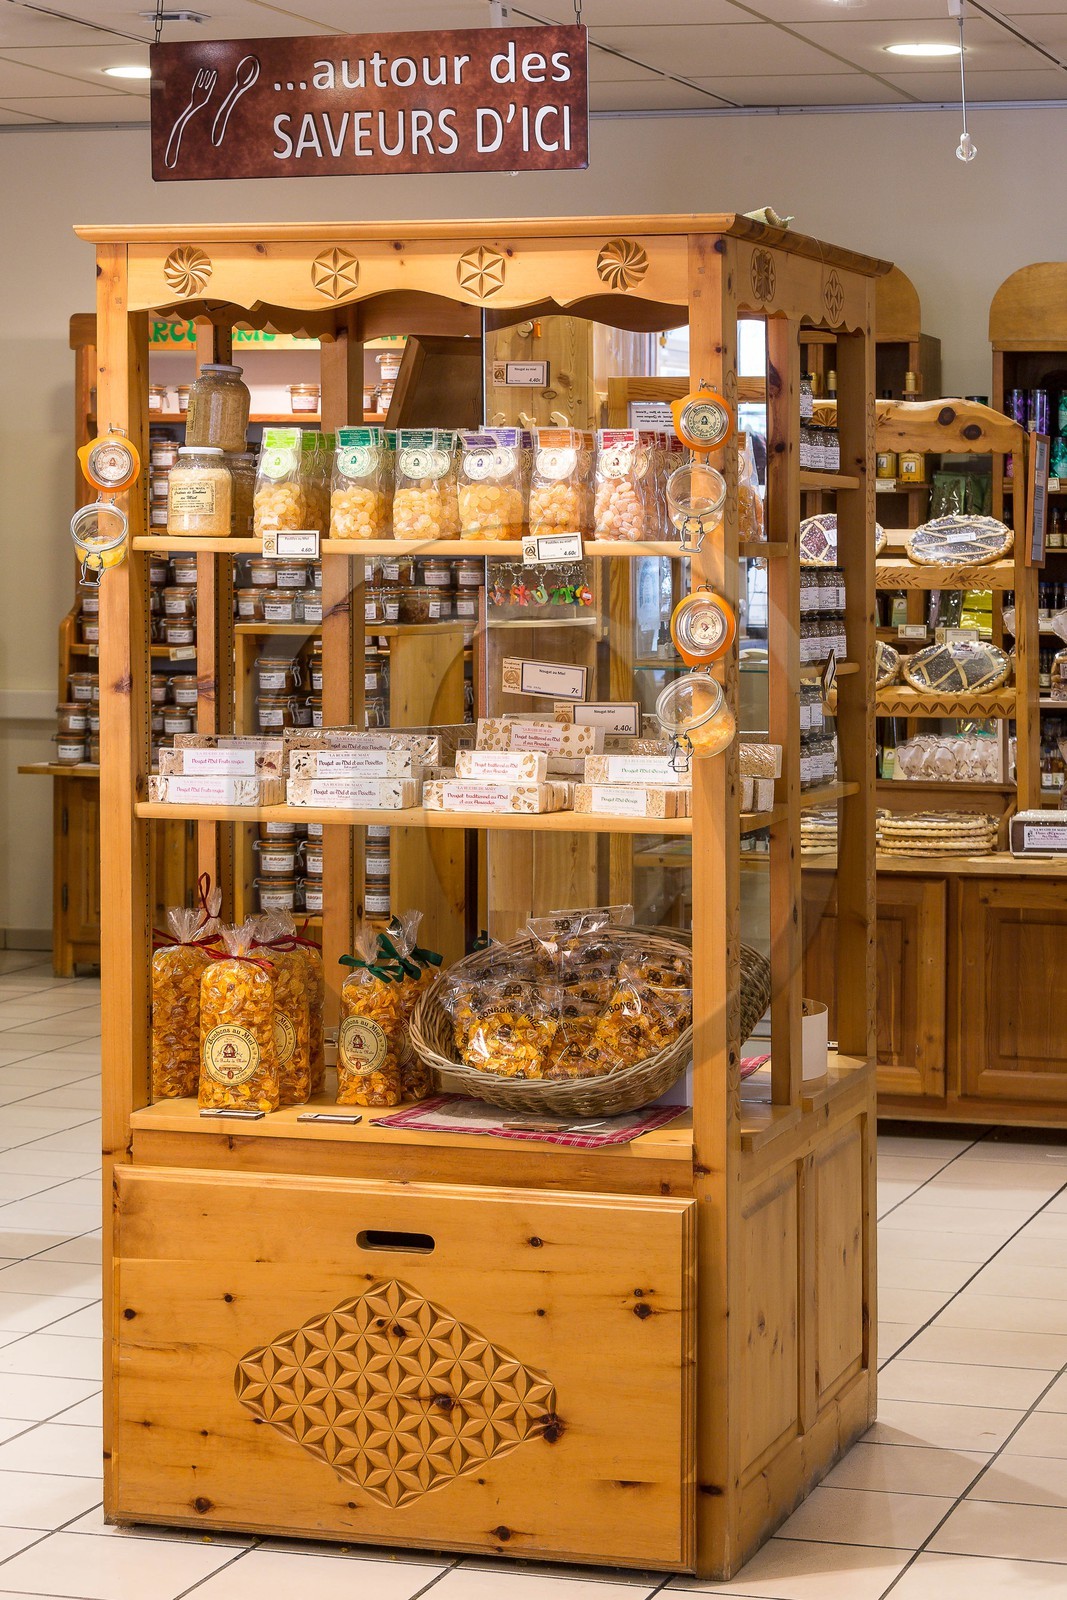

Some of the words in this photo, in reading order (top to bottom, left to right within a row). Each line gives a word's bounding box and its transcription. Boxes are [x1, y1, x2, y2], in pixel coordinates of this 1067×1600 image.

[274, 51, 470, 91] ...autour
[490, 41, 571, 83] des
[273, 108, 460, 160] SAVEURS
[476, 103, 571, 154] D'ICI
[477, 1006, 517, 1020] BONBONS
[525, 1014, 540, 1030] MIEL
[655, 1018, 670, 1037] MIEL
[207, 1029, 230, 1044] Bonbons
[242, 1032, 256, 1045] Miel
[369, 1024, 382, 1038] Miel
